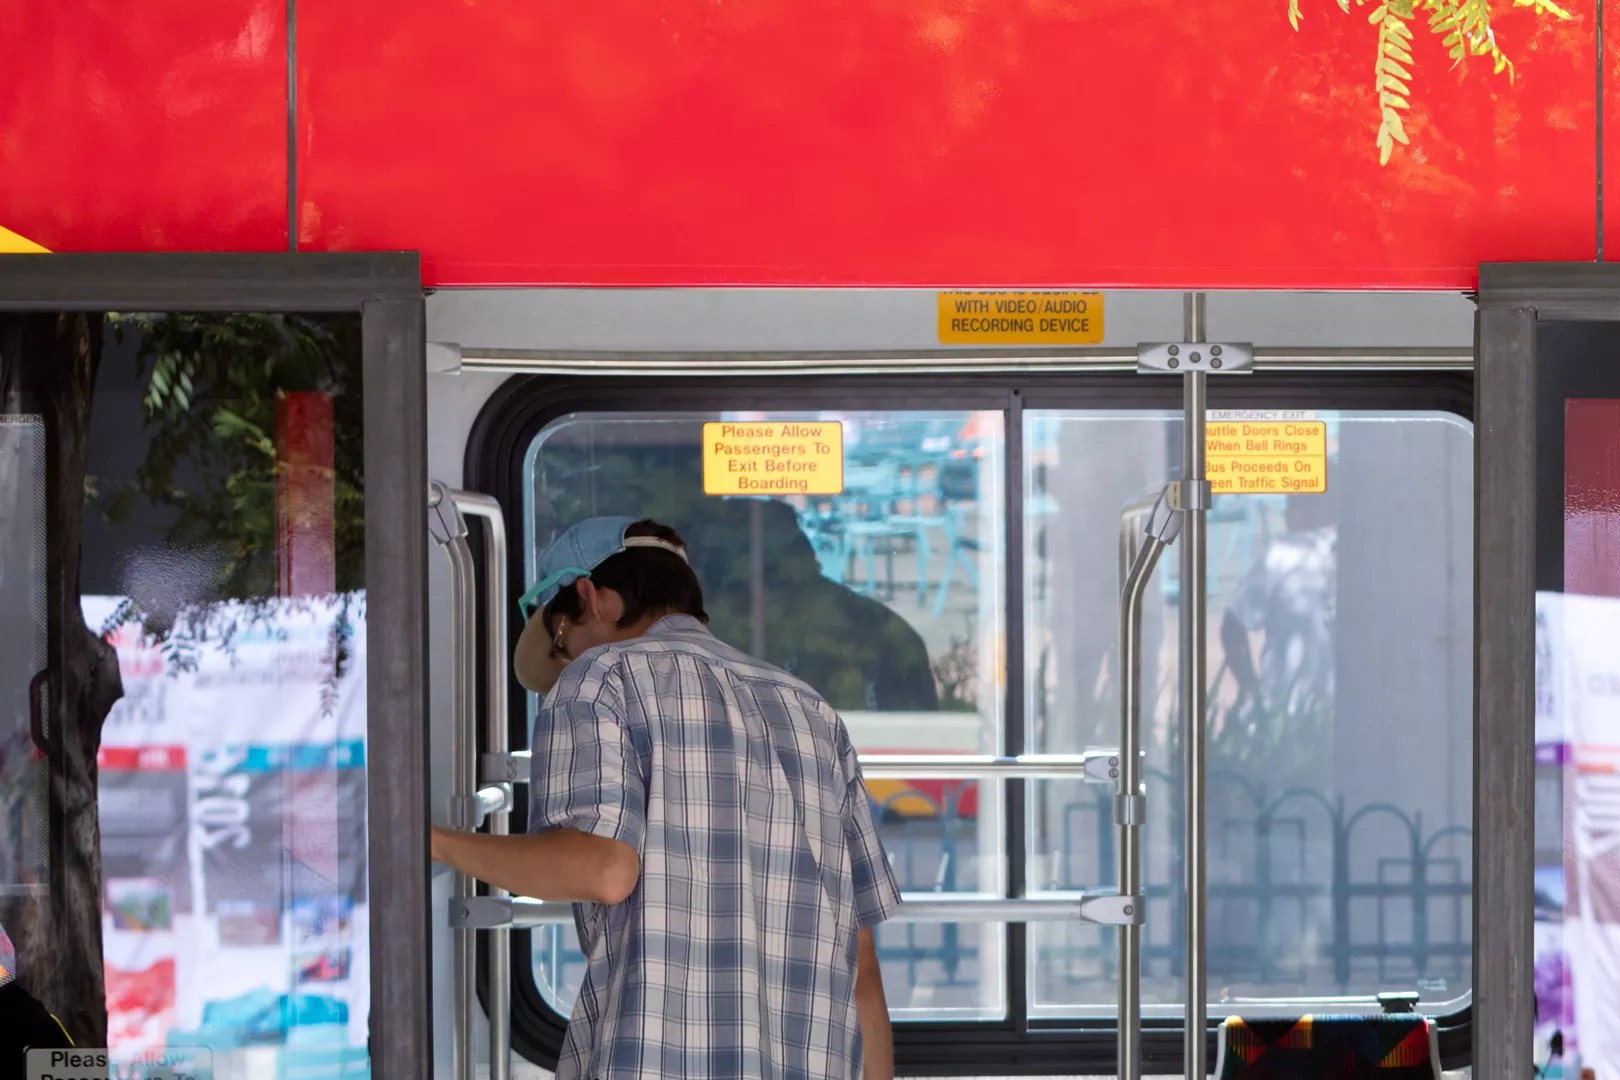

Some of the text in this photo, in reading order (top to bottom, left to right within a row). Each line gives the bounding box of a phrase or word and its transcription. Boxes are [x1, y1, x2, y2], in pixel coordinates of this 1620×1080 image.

[954, 299, 1087, 315] WITH VIDEO/AUDIO
[951, 317, 1090, 332] RECORDING DEVICE
[1211, 411, 1306, 419] EMERGENCY EXIT
[721, 424, 823, 438] Please Allow
[1242, 425, 1279, 436] Doors
[1284, 425, 1320, 436] Close
[714, 441, 831, 457] Passengers To
[1206, 440, 1307, 453] When Bell Rings
[727, 459, 817, 472] Exit Before
[1231, 461, 1288, 472] Proceeds
[1294, 461, 1311, 472] On
[738, 476, 809, 491] Boarding
[1211, 476, 1320, 490] een Traffic Signal
[51, 1051, 110, 1068] Pleas
